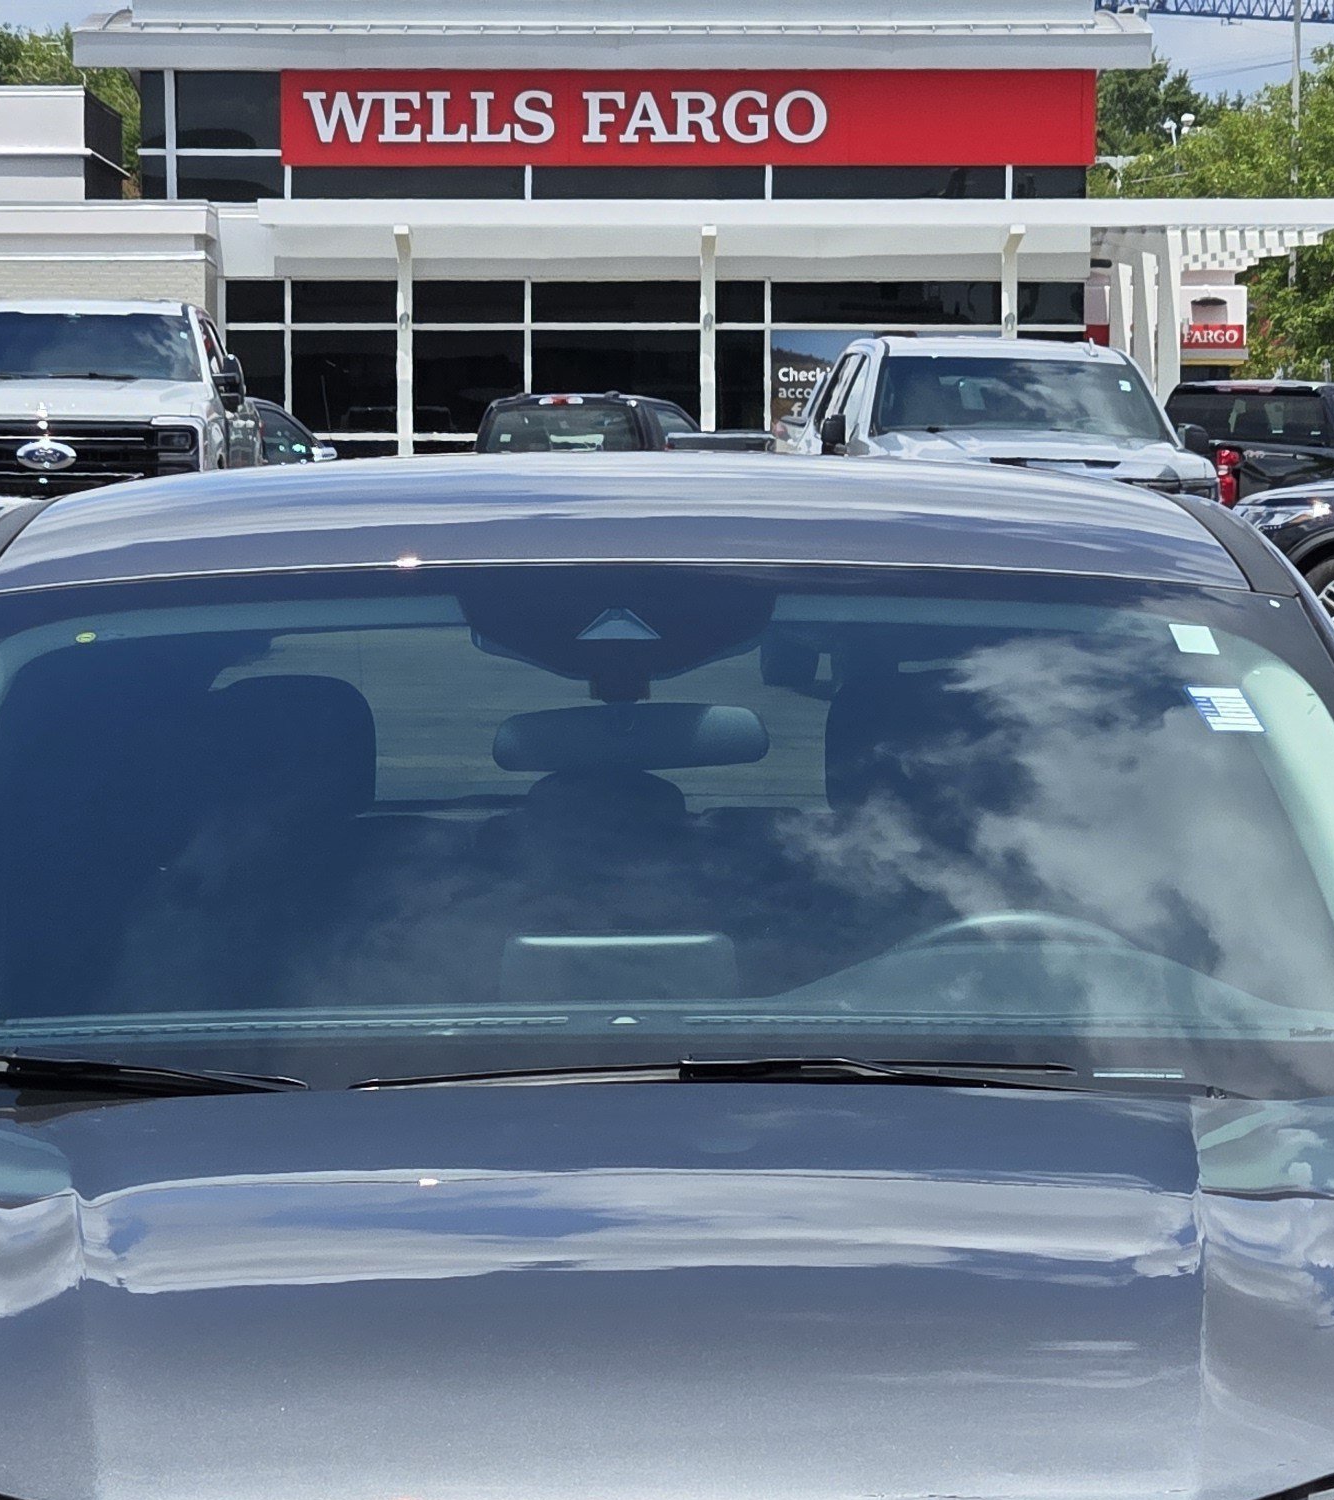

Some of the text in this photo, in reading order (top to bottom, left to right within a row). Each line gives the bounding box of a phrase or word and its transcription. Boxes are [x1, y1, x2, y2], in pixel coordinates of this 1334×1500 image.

[303, 91, 827, 143] WELLS FARGO
[1182, 329, 1239, 343] FARGO
[778, 366, 832, 382] Check
[778, 387, 814, 399] acco
